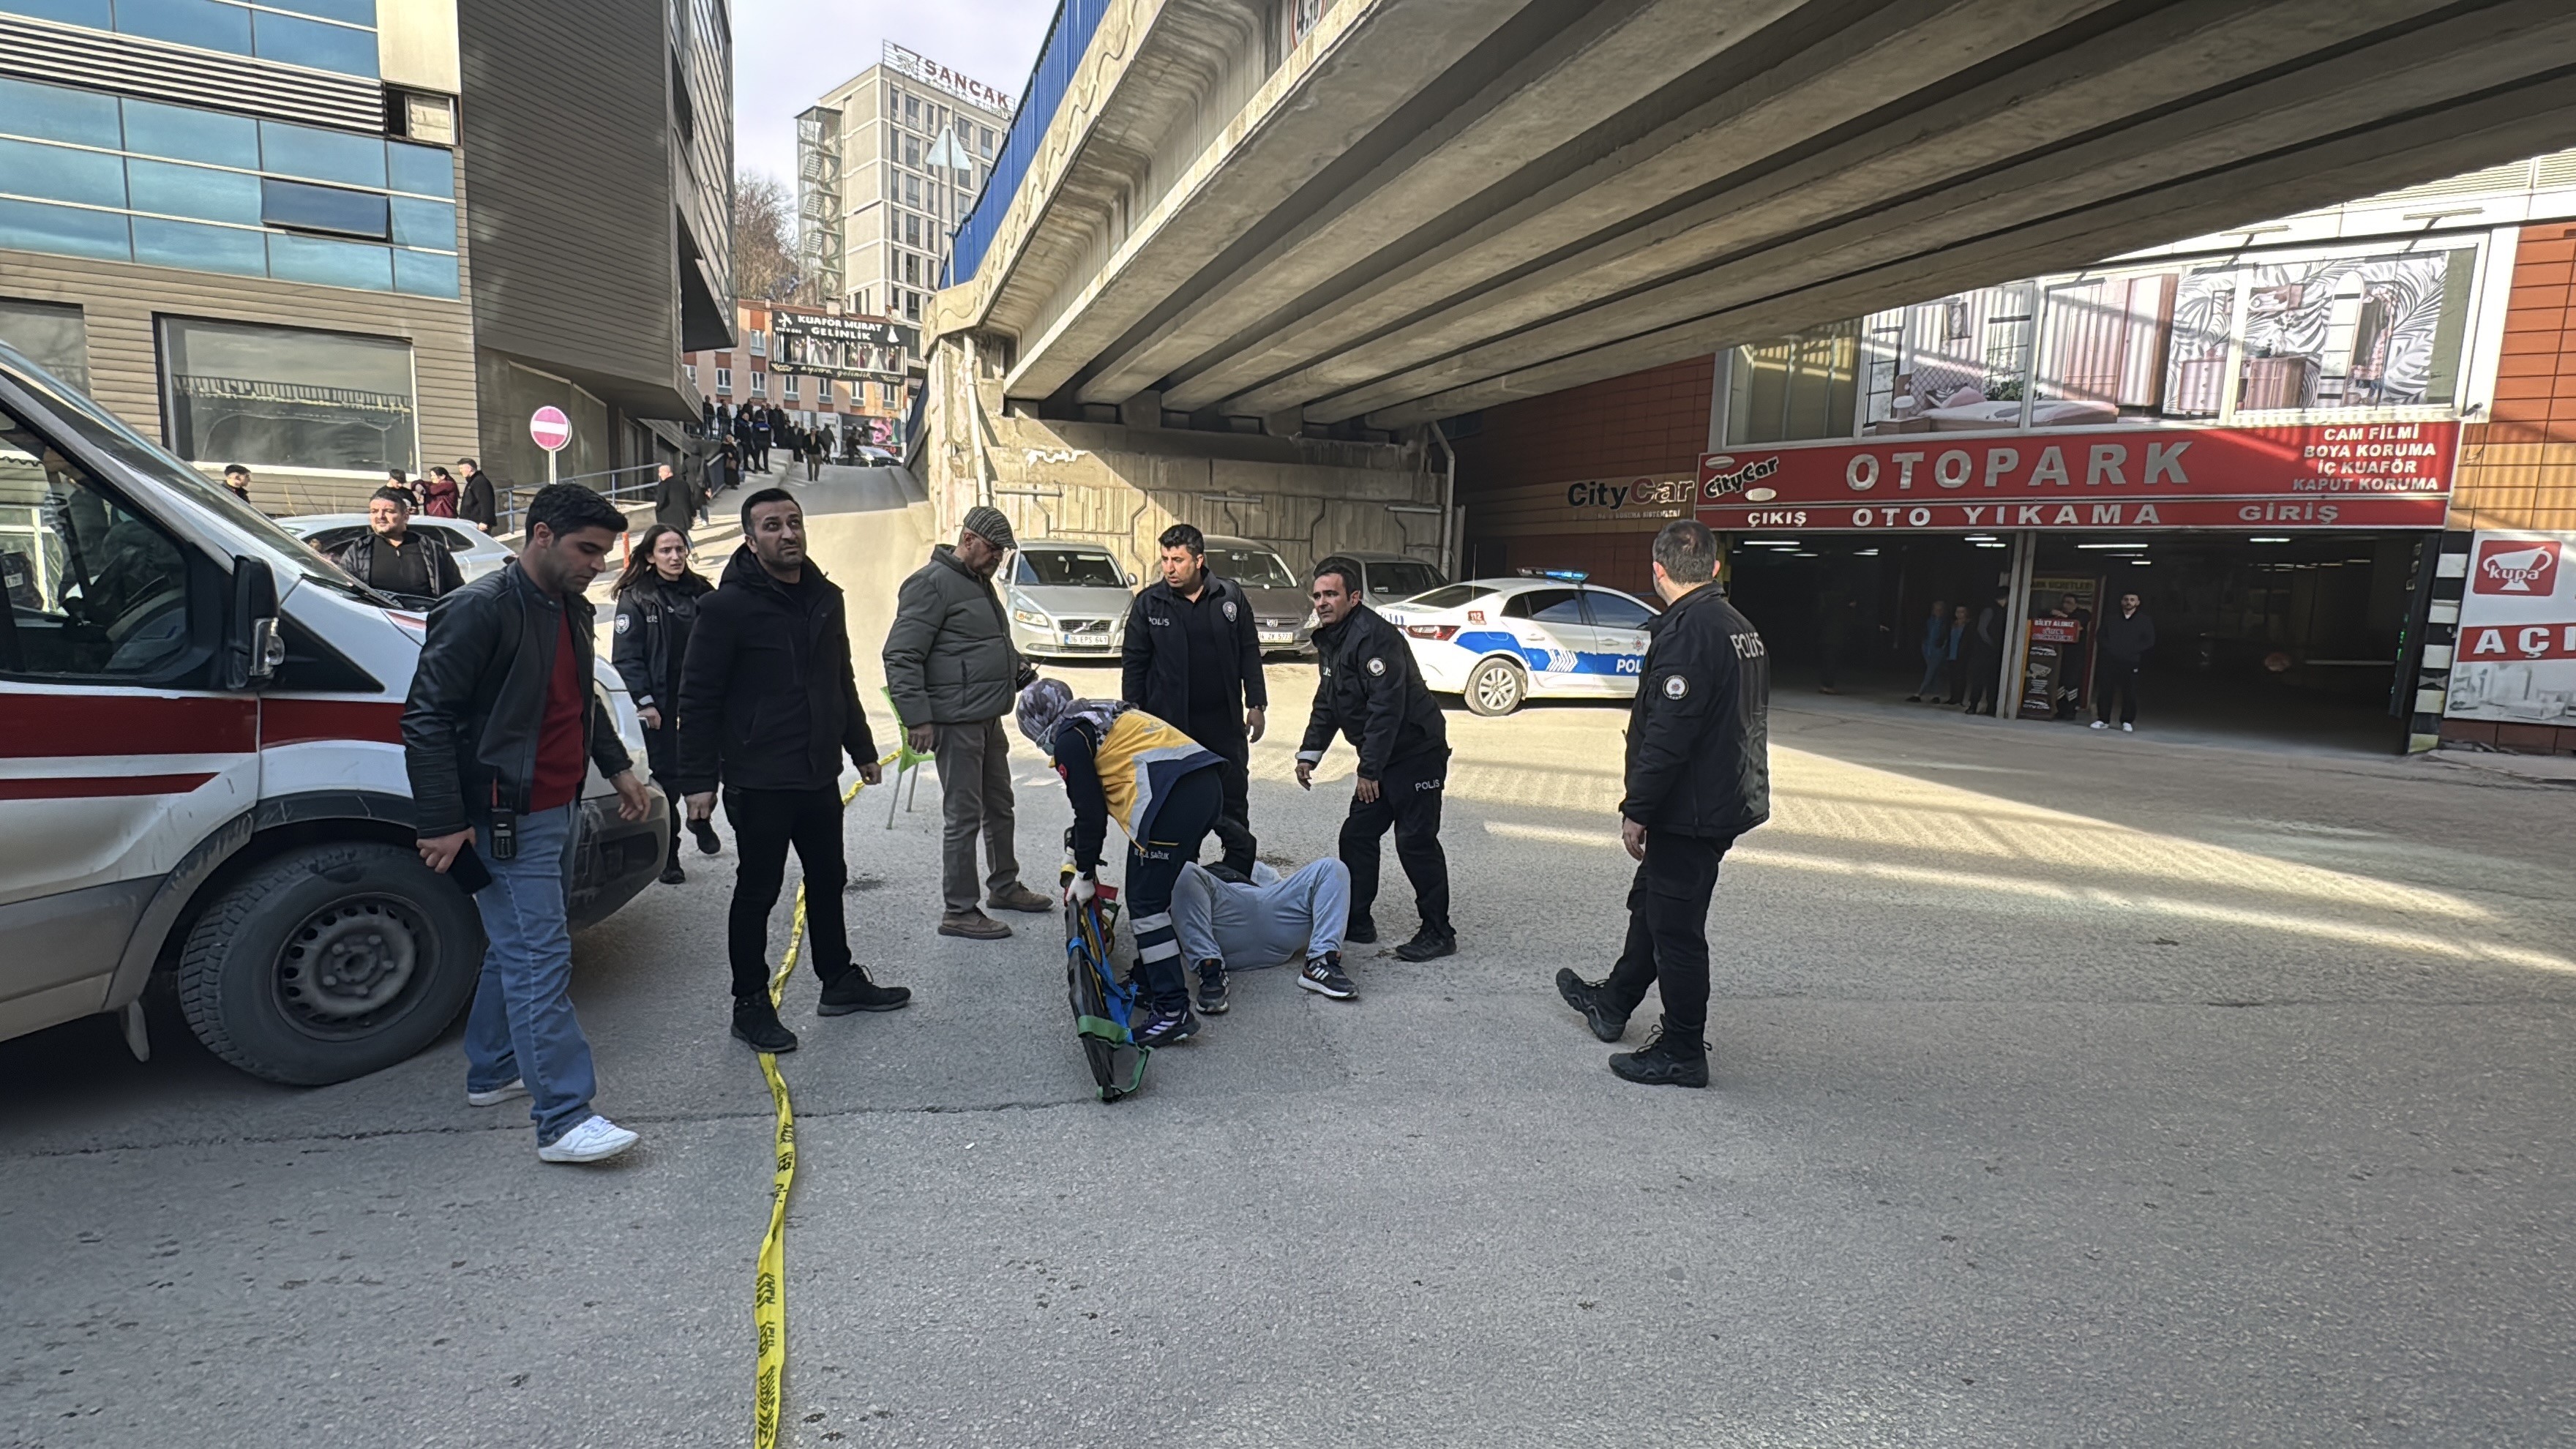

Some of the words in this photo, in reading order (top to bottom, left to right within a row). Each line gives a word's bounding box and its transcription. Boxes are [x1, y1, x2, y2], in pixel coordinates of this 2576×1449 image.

[924, 59, 1008, 108] SANCAK
[797, 315, 842, 328] KUAFÖR
[844, 320, 883, 332] MURAT
[811, 326, 872, 340] GELİNLİK
[2324, 428, 2363, 441] CAM
[2368, 424, 2419, 440] FİLMİ
[2304, 445, 2351, 457] BOYA
[2356, 443, 2436, 457] KORUMA
[1846, 441, 2193, 491] OTOPARK
[2318, 460, 2337, 476] İÇ
[2341, 459, 2417, 473] KUAFÖR
[1704, 456, 1779, 498] CityCar
[2293, 479, 2354, 491] KAPUT
[2359, 477, 2438, 490] KORUMA
[1748, 511, 1807, 527] ÇIKIŞ
[1852, 507, 1931, 526] OTO
[1962, 503, 2161, 525] YIKAMA
[2239, 502, 2339, 524] GİRİŞ
[2489, 565, 2539, 583] kupa
